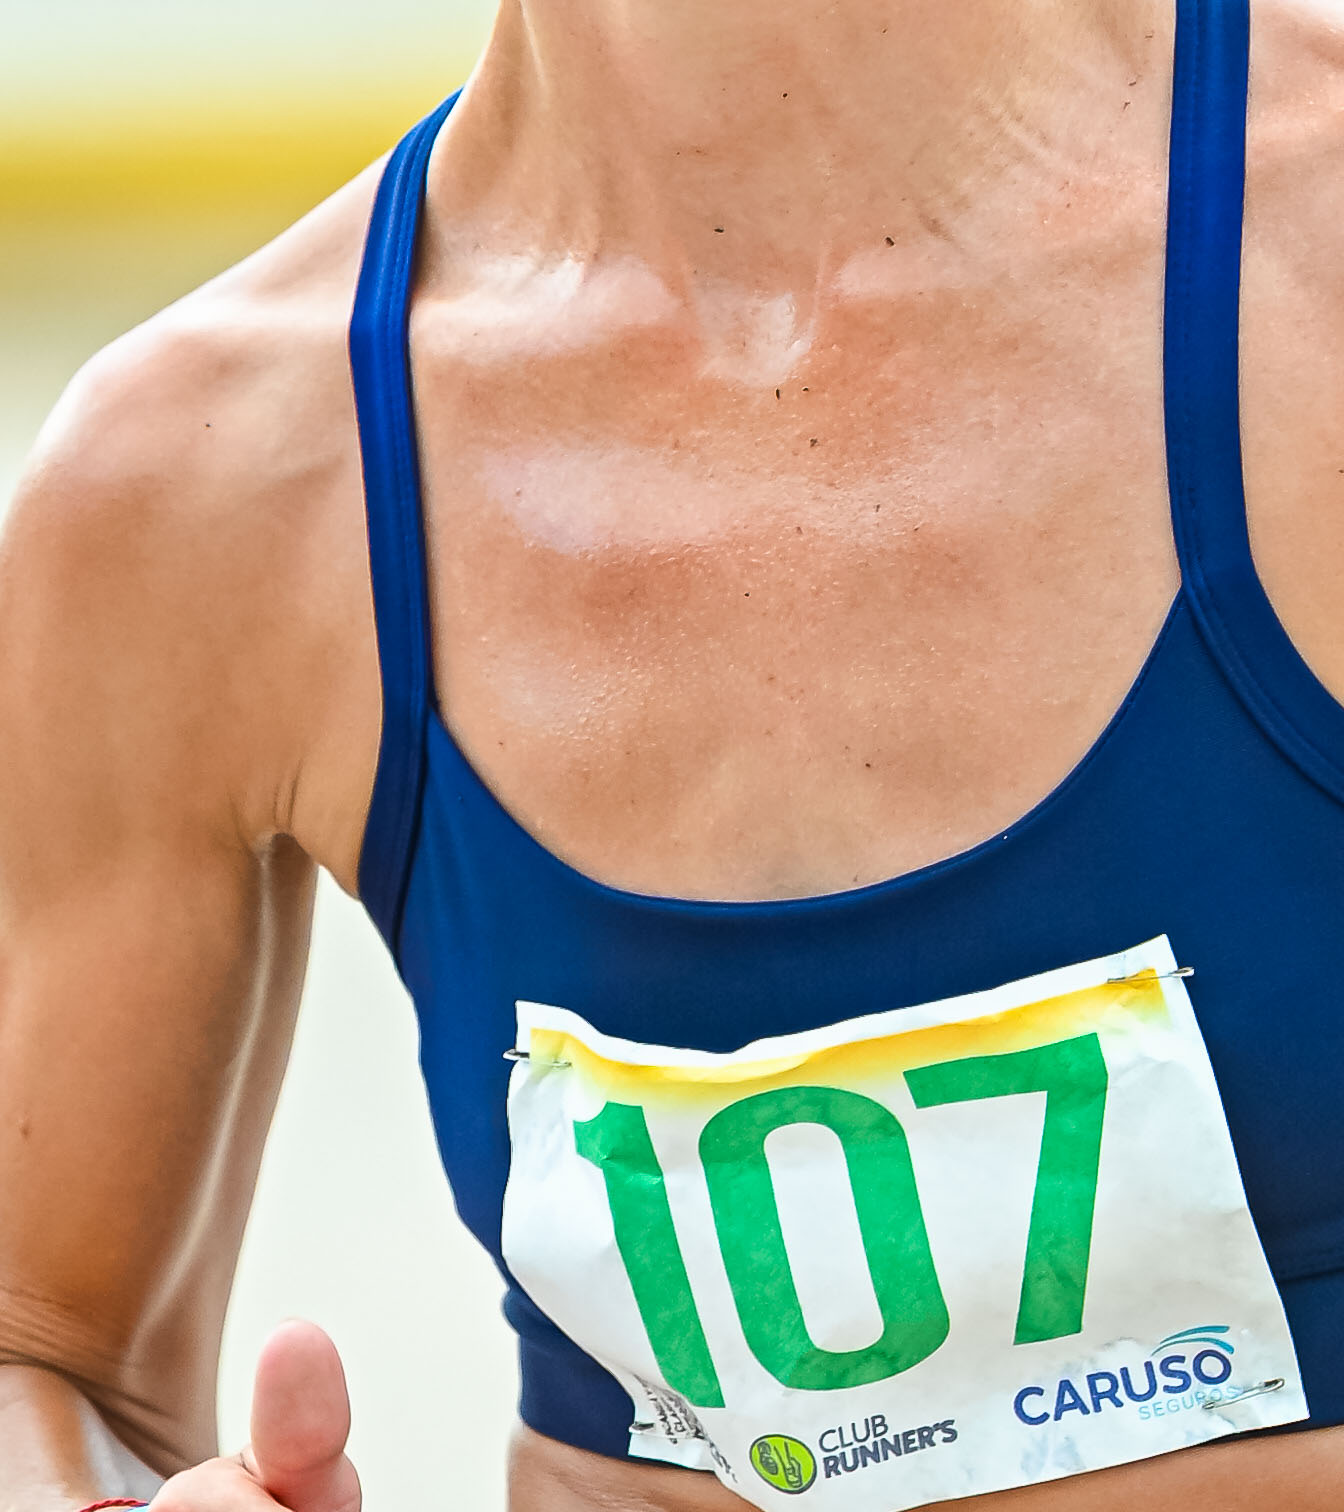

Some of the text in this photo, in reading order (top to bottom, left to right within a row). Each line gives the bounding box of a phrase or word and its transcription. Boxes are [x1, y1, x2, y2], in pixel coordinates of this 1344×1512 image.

[573, 1032, 1109, 1409] 107
[1013, 1349, 1233, 1426] CARUSO
[1138, 1386, 1244, 1420] SEGUROS
[819, 1414, 889, 1453] CLUB
[822, 1419, 959, 1479] RUNNER'S
